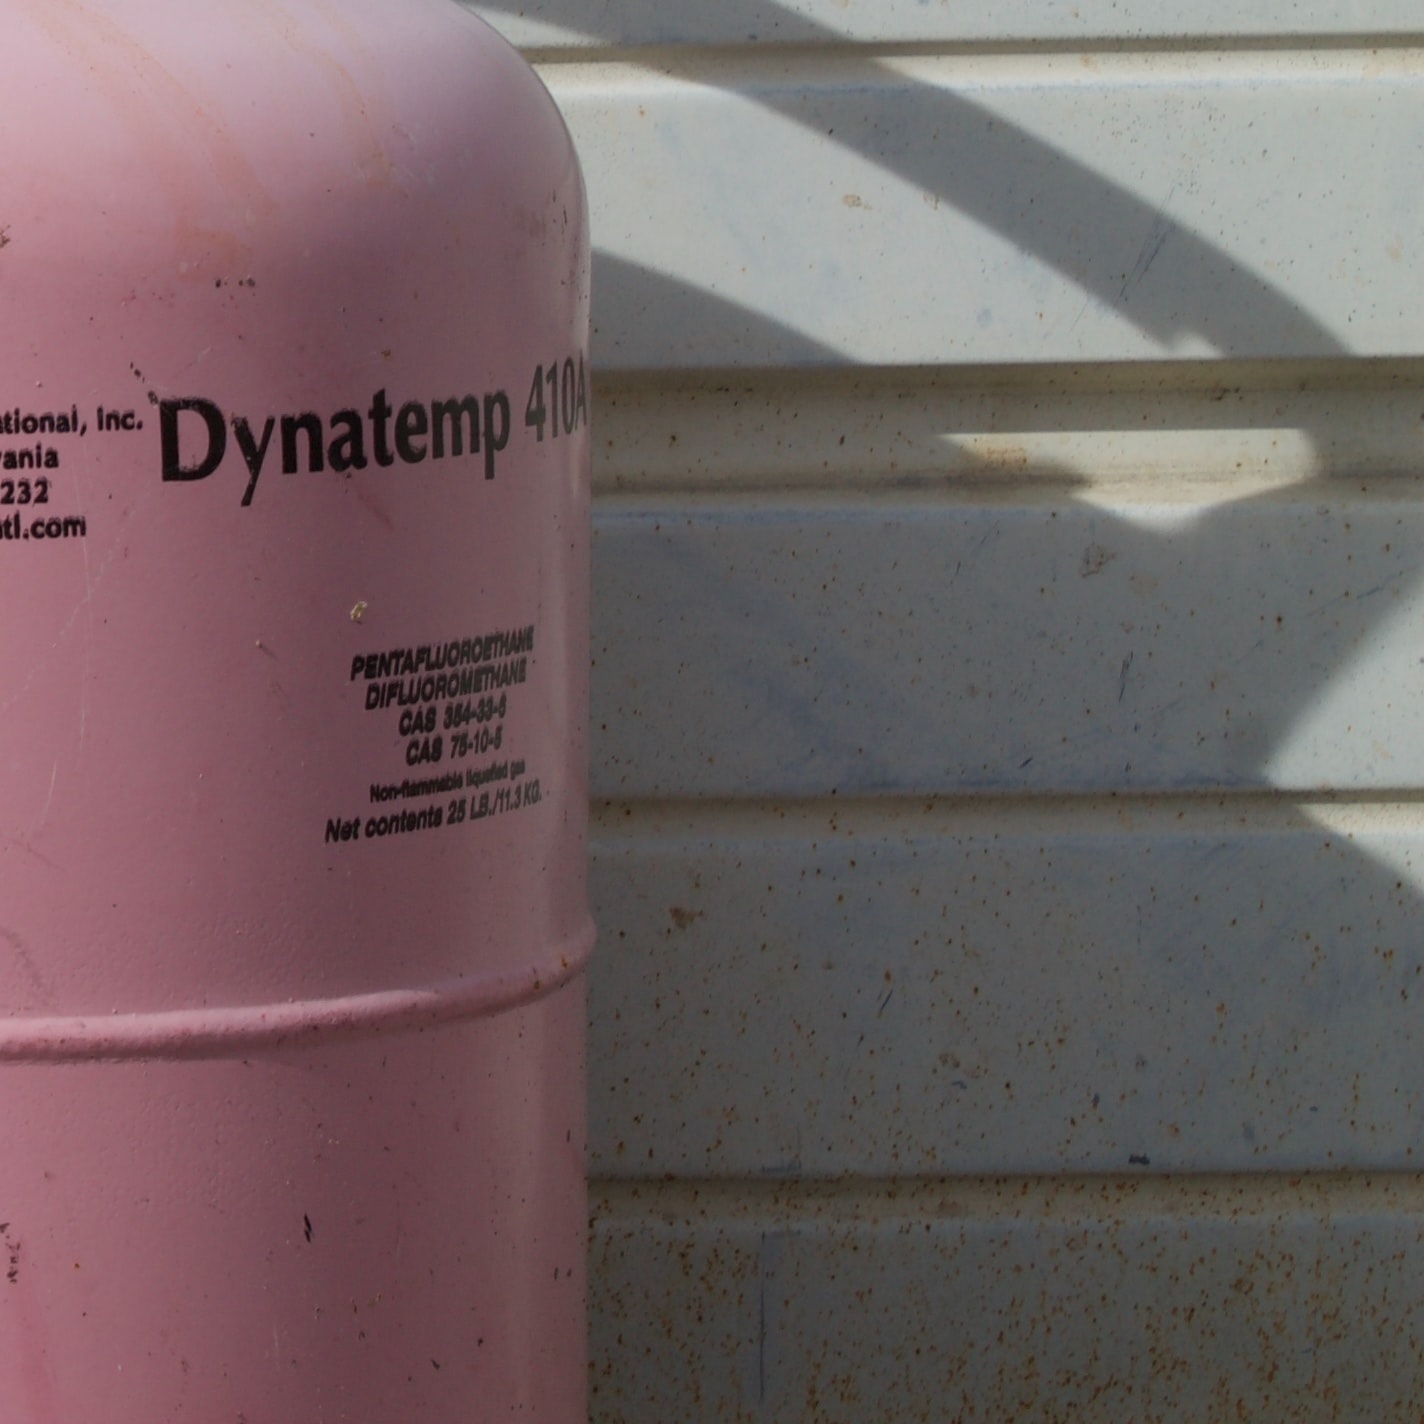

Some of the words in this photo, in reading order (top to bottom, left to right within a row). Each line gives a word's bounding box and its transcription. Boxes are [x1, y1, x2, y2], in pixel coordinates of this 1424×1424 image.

[96, 406, 143, 432] Inc.
[159, 388, 511, 507] Dynatemp
[524, 351, 587, 442] 410A
[350, 624, 535, 681] PENTAFLUOROETHANE
[365, 656, 527, 710] DIFLUOROMETHANE
[399, 705, 437, 736] CAS
[406, 734, 442, 766] CAS
[324, 819, 360, 844] Net
[365, 806, 443, 839] contents
[446, 799, 467, 825] 25
